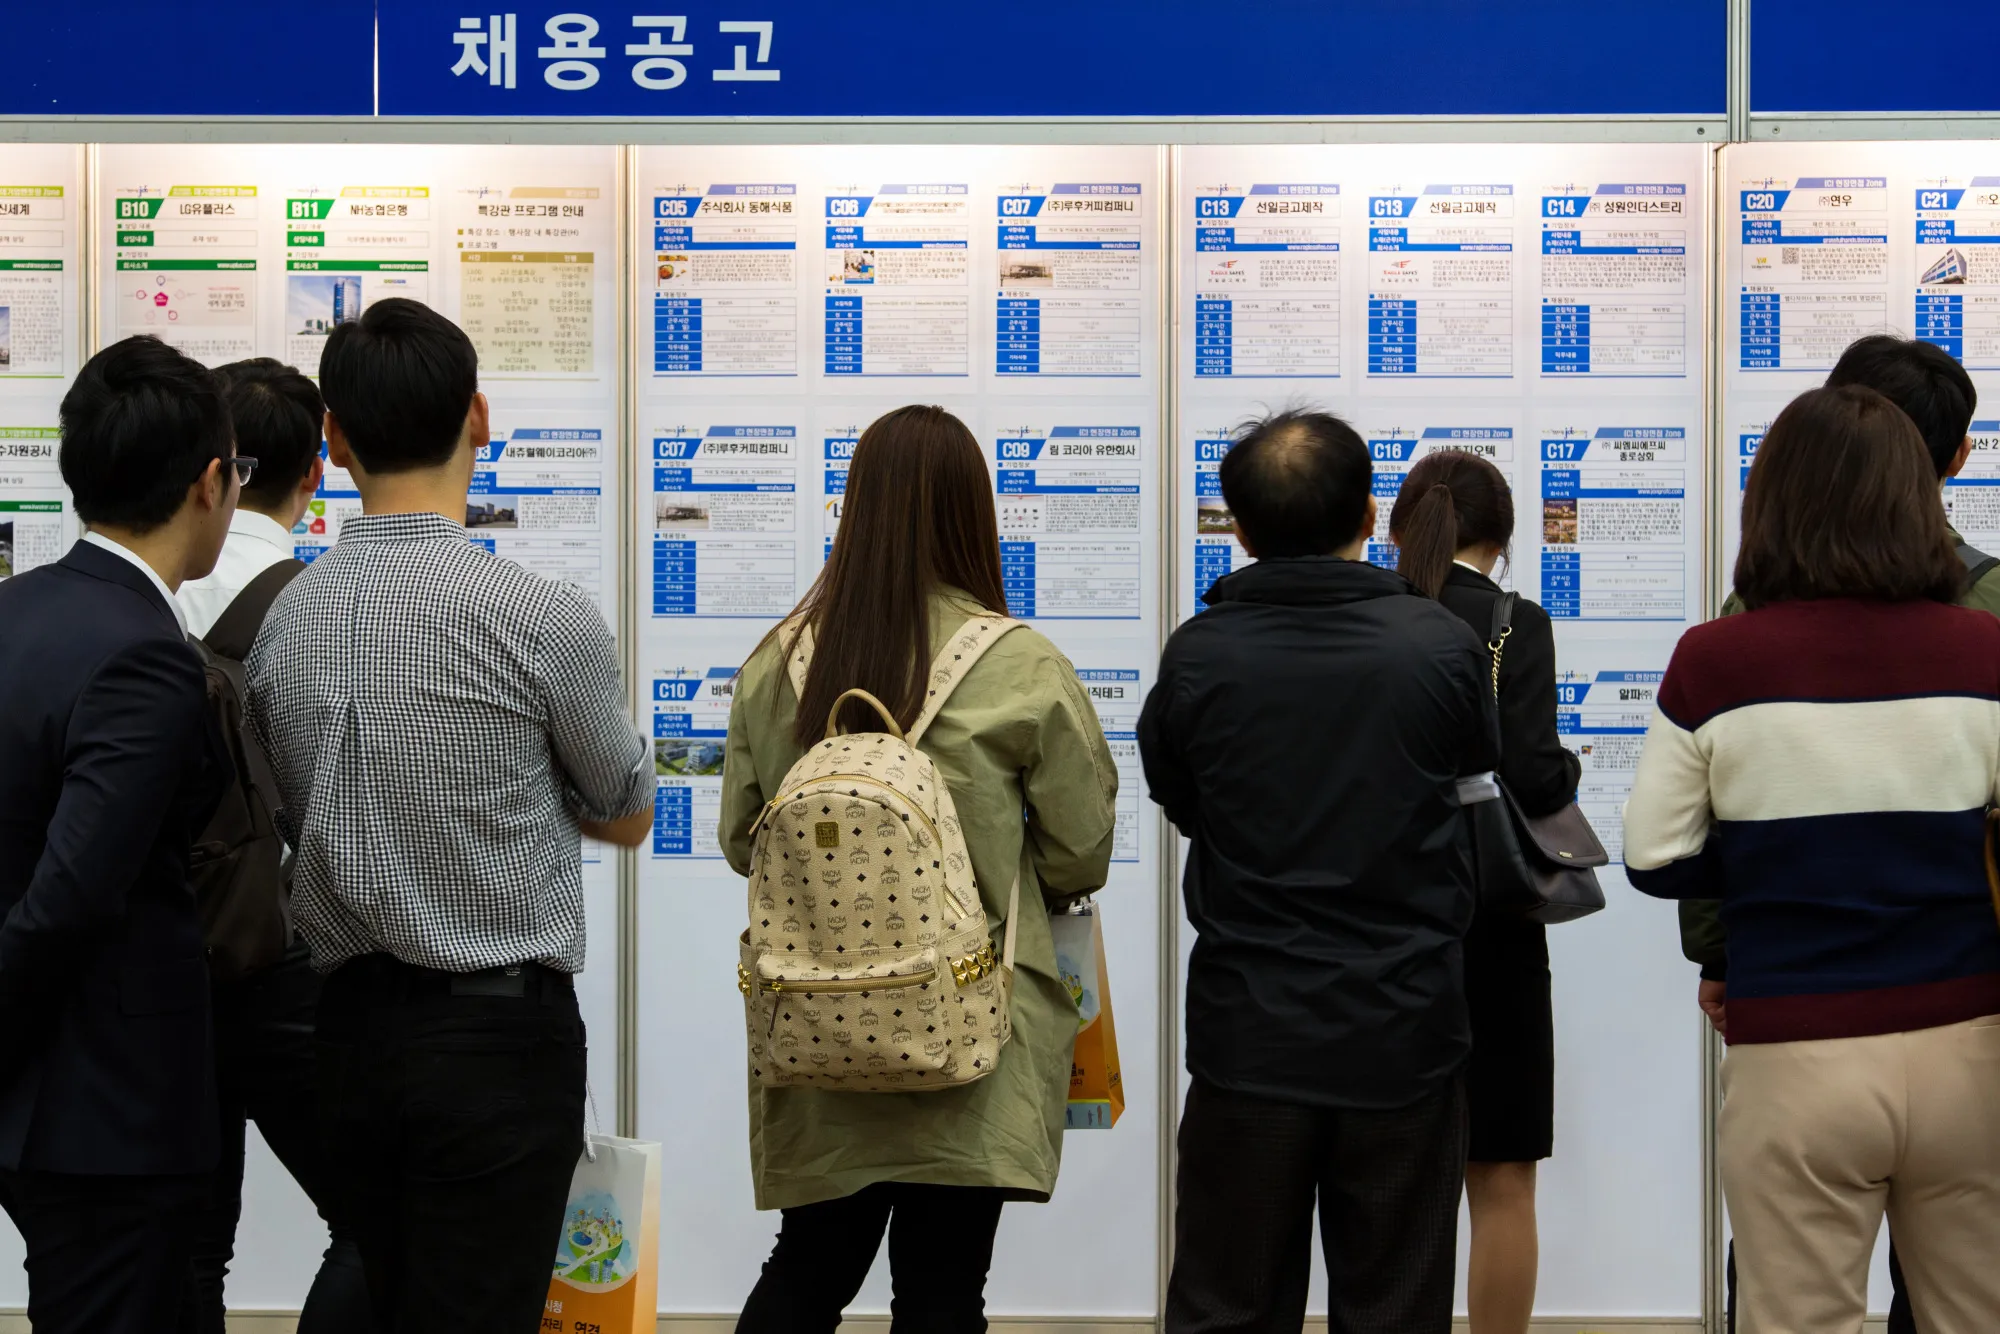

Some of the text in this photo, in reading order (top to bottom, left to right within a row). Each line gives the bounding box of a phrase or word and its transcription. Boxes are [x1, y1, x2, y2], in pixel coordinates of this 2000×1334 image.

[450, 13, 780, 90] 채용공고
[660, 200, 687, 215] C05
[702, 201, 792, 213] 주식회사 동해식품
[831, 200, 858, 215] C06
[1003, 199, 1030, 215] C07
[1202, 200, 1229, 215] C13
[1257, 201, 1323, 213] 선일금고제작
[1430, 202, 1496, 213] 선일금고제작
[1548, 200, 1575, 215] C14
[1605, 201, 1681, 213] 성원인더스트리
[1747, 194, 1774, 209] C20
[1921, 192, 1947, 208] C21
[122, 202, 149, 217] B10
[180, 204, 235, 214] LG유플러스
[292, 202, 318, 217] B11
[351, 205, 408, 216] NH농협은행
[479, 205, 584, 217] 특강관 프로그램 안내
[1375, 200, 1402, 216] C13
[476, 445, 491, 459] 03
[659, 441, 686, 457] C07
[830, 442, 858, 457] C08
[1003, 442, 1030, 457] C09
[1050, 445, 1135, 455] 림 코리아 유한회사
[1201, 444, 1228, 459] C15
[1374, 443, 1402, 459] C16
[1547, 443, 1574, 458] C17
[1620, 452, 1654, 461] 종로상회
[659, 683, 686, 698] C10
[1558, 687, 1575, 702] 19
